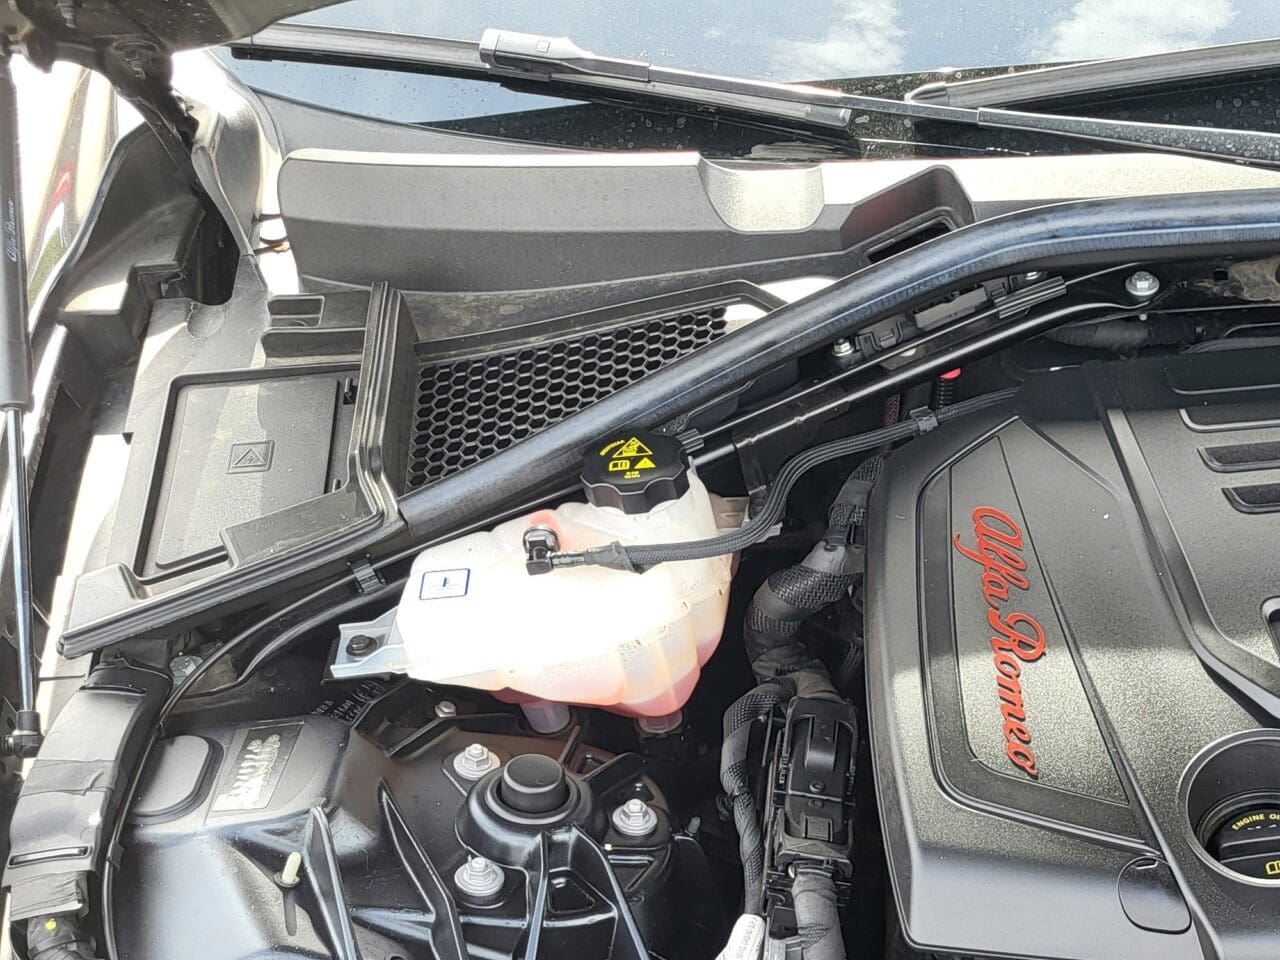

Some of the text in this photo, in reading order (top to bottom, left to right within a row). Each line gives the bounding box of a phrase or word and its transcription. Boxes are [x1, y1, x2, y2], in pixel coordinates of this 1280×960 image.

[953, 506, 1046, 778] Alfa Romeo
[1231, 813, 1265, 830] ENGINE
